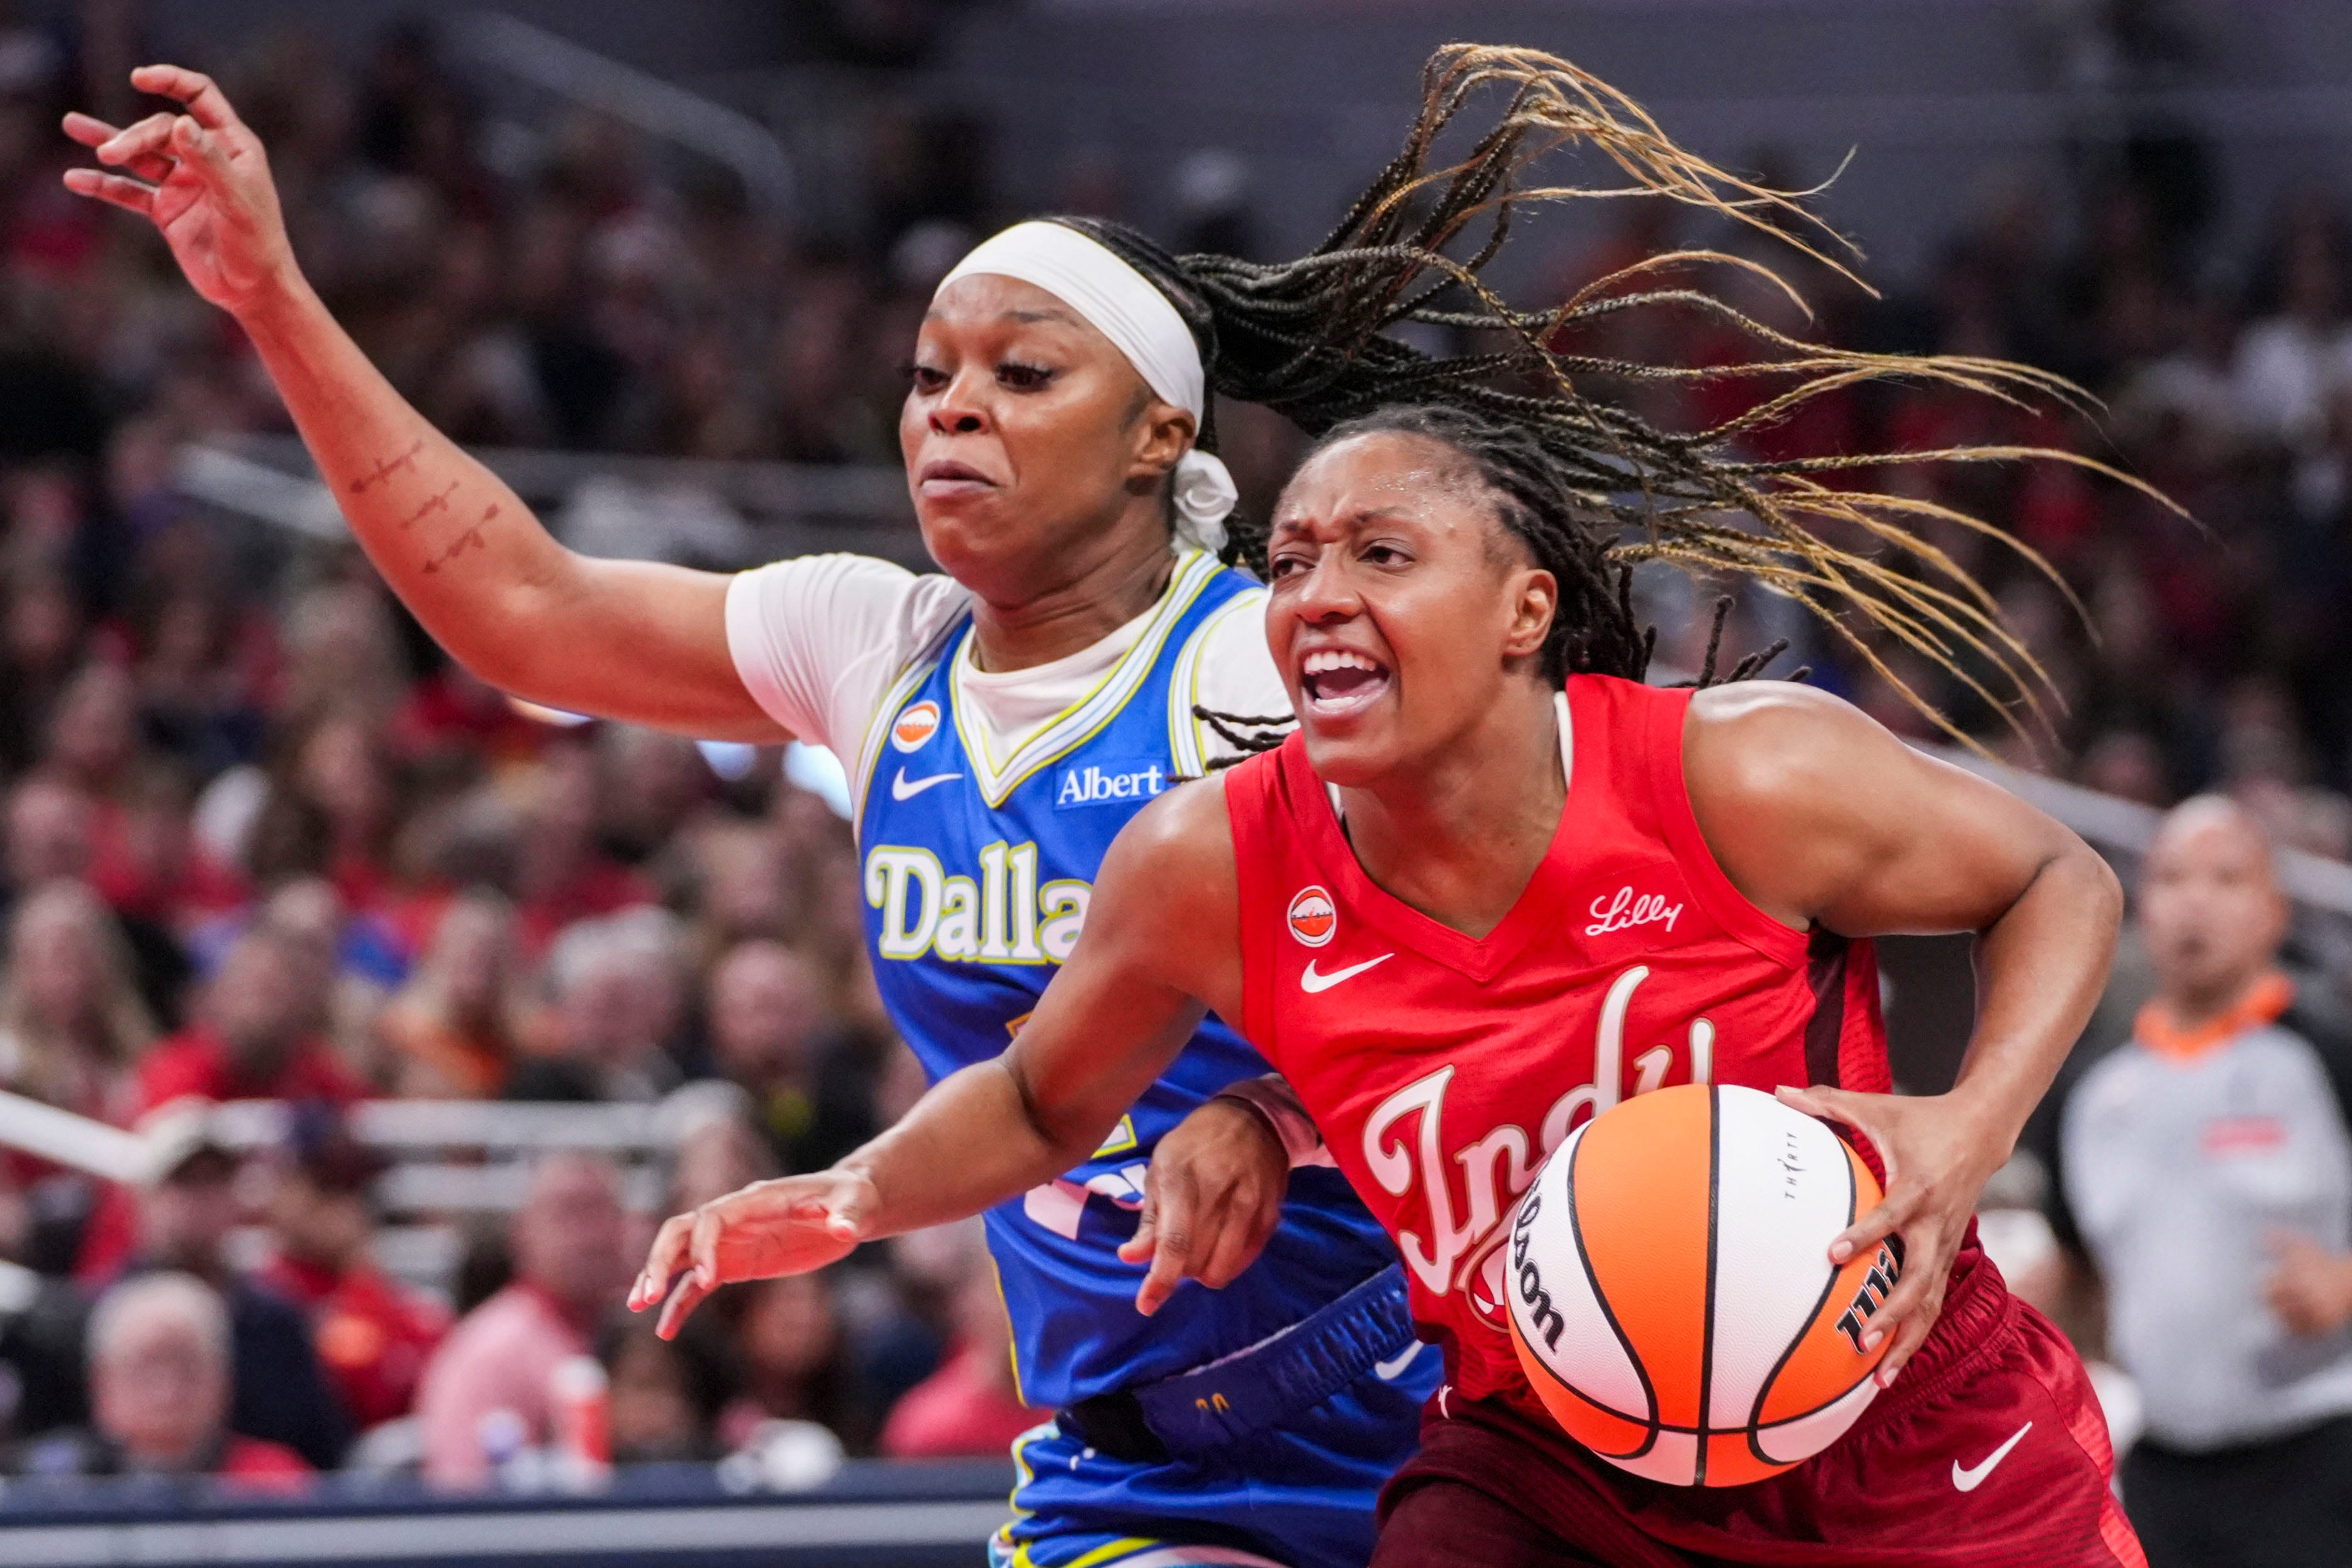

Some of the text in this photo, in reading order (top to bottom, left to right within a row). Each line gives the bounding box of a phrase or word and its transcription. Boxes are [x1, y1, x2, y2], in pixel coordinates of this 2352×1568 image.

[1056, 765, 1163, 804] Albert
[865, 840, 1093, 966] Dalla
[1585, 886, 1684, 937] Lilly
[1514, 1151, 1565, 1354] ilson
